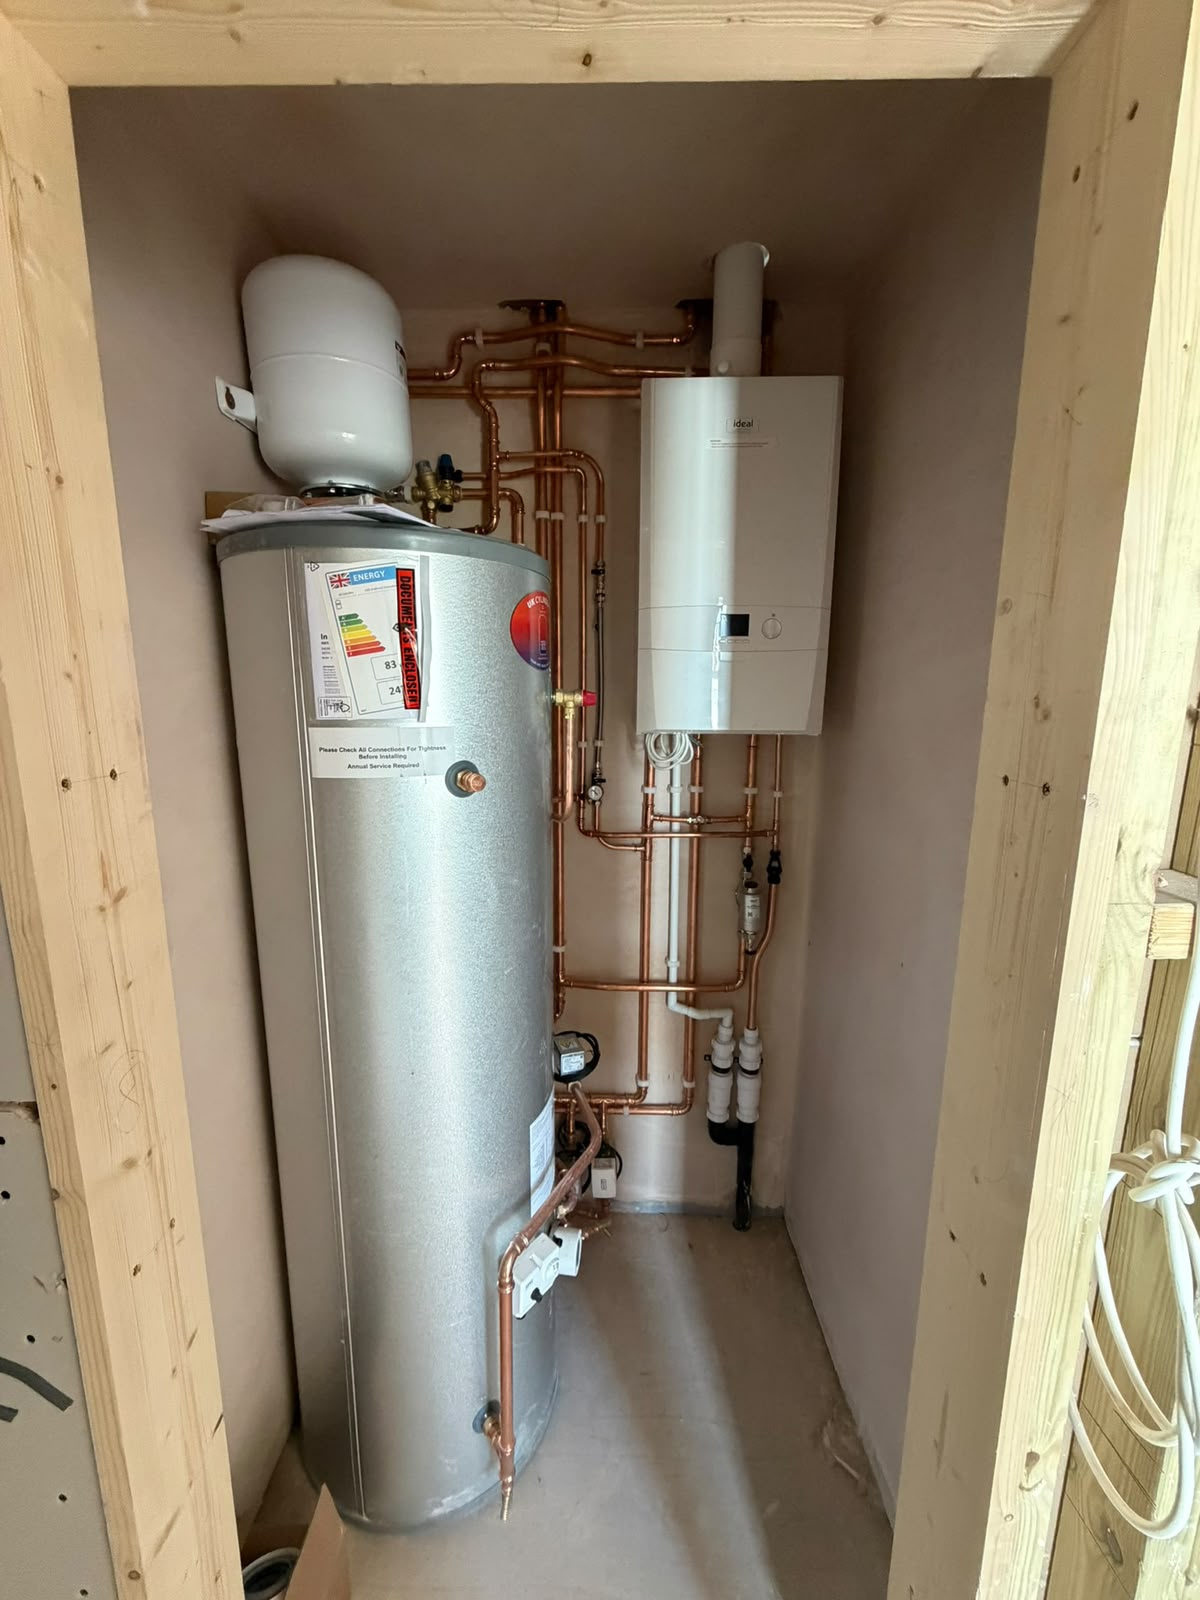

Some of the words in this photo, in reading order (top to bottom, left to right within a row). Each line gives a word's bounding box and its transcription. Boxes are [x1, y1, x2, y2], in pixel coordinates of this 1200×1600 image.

[733, 418, 754, 428] ideal
[353, 570, 385, 582] ENERGY
[384, 660, 397, 669] 83
[388, 685, 403, 695] 24
